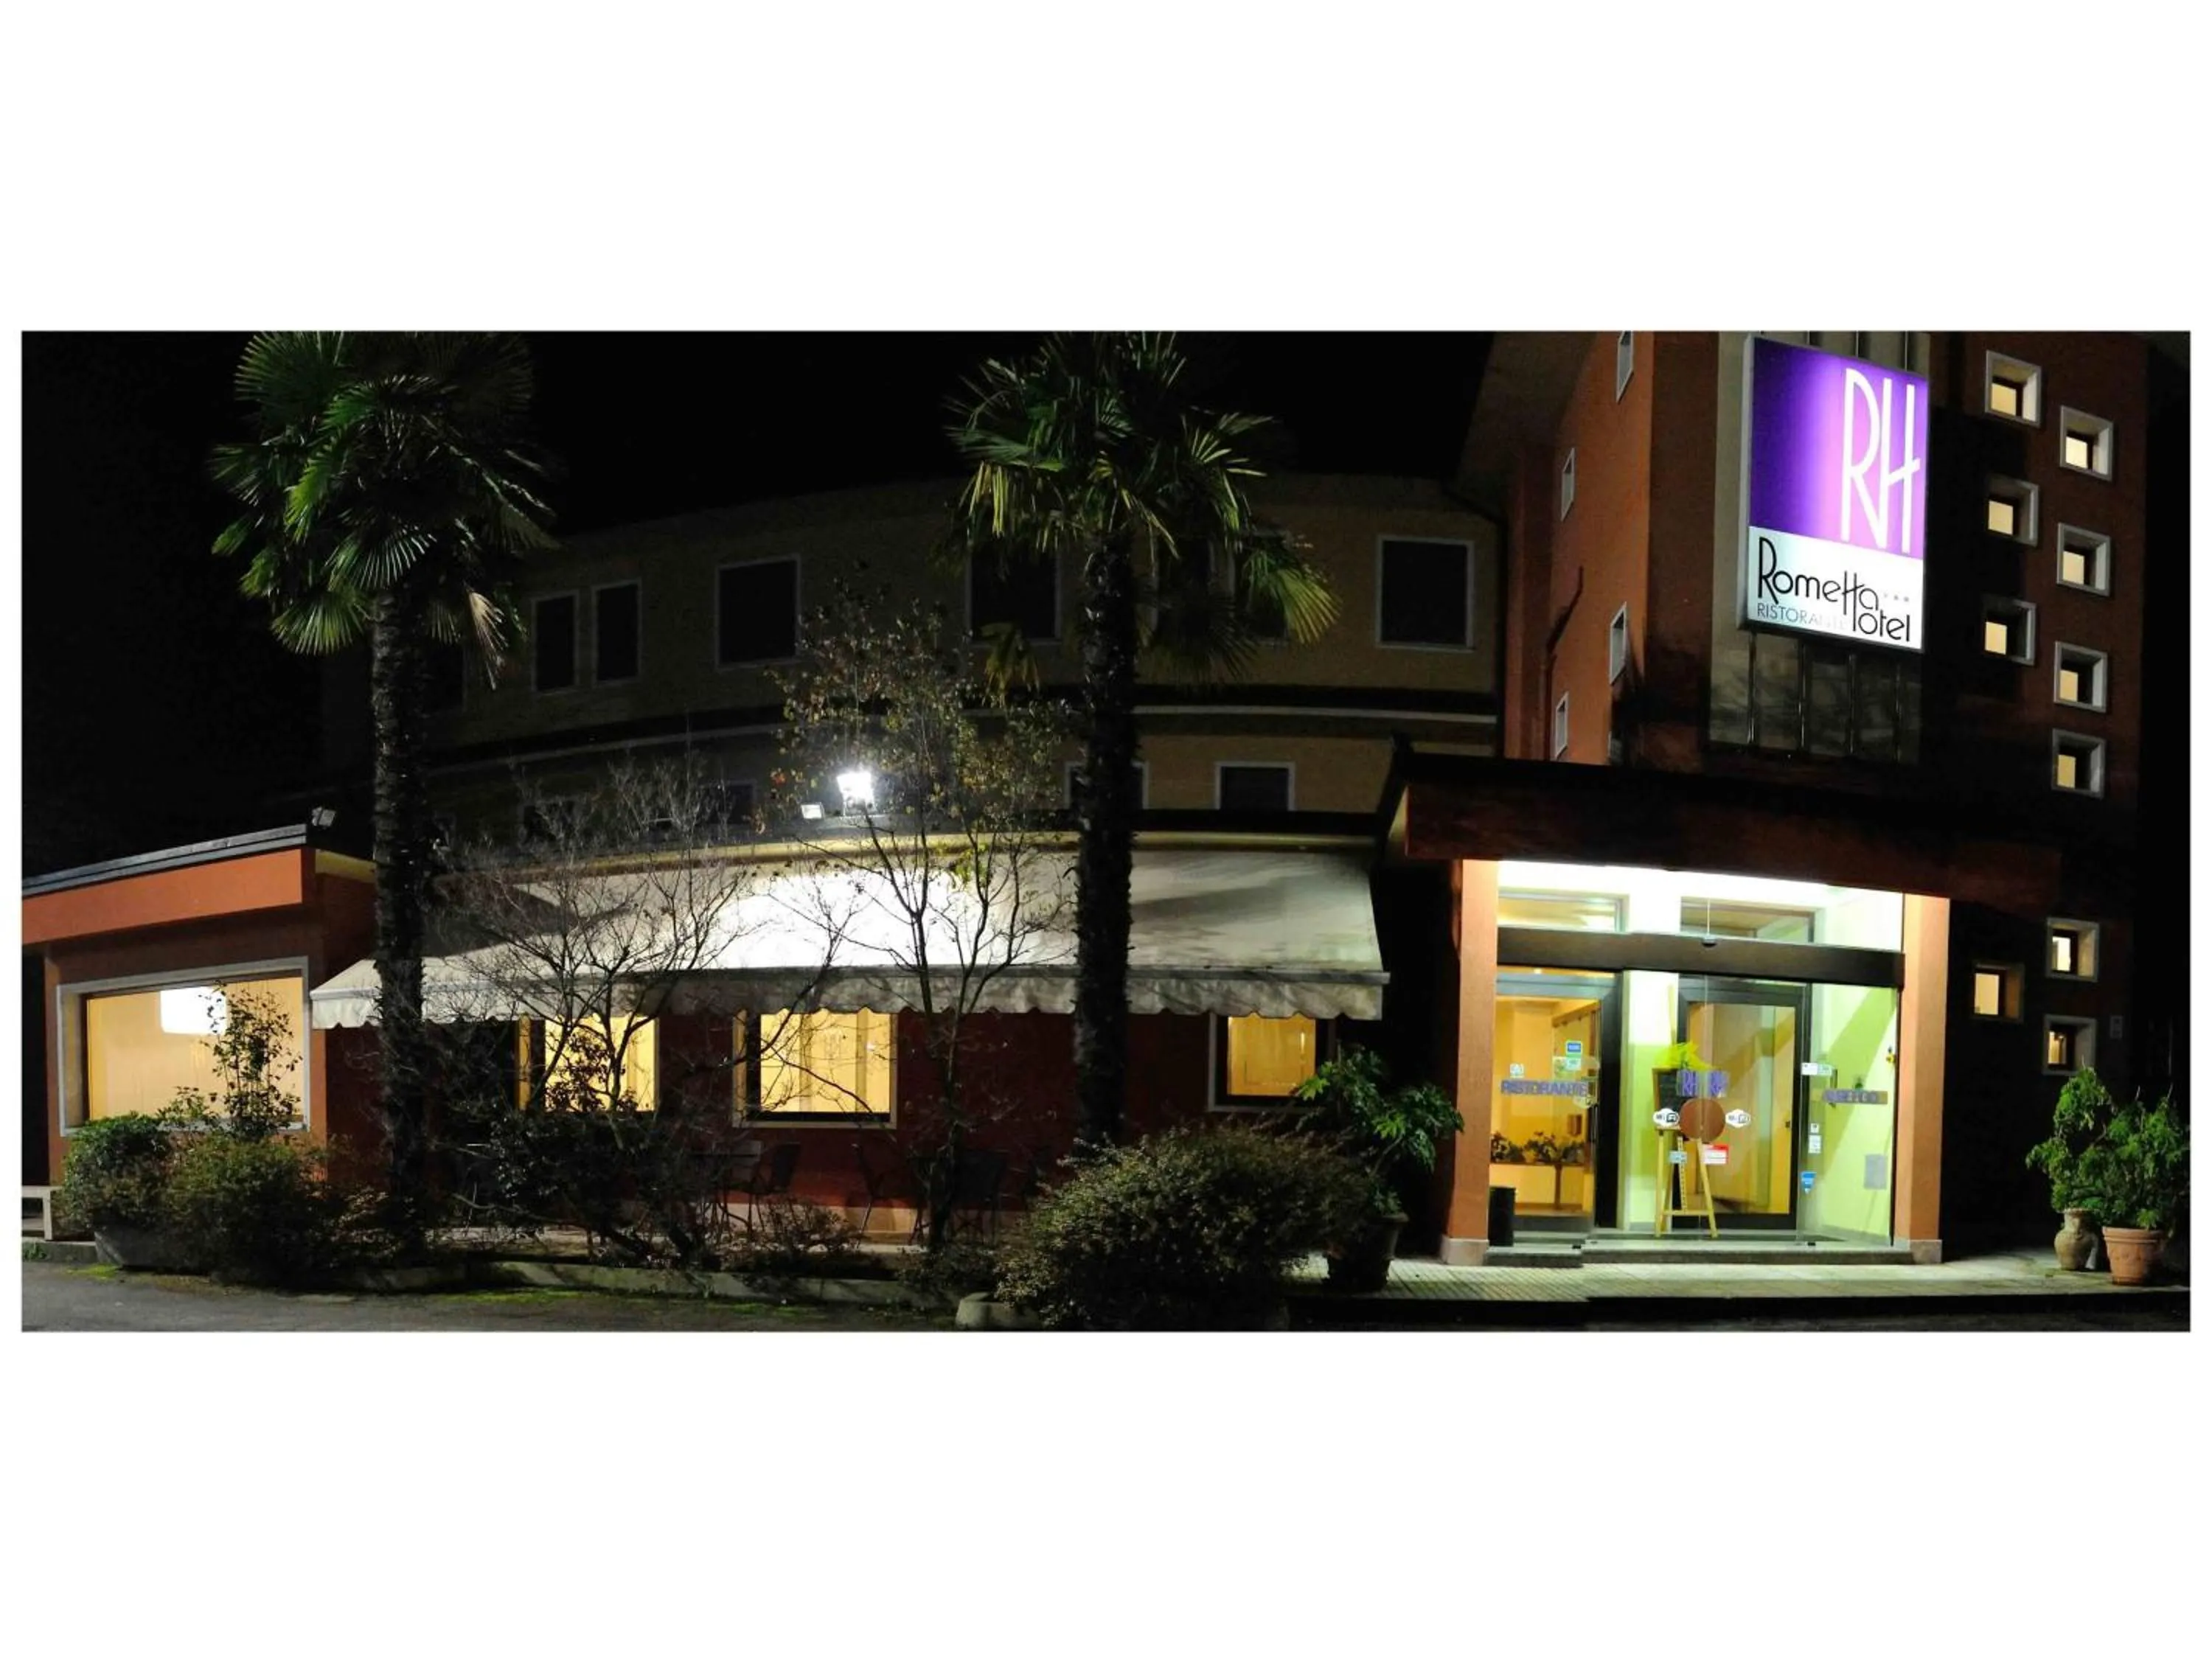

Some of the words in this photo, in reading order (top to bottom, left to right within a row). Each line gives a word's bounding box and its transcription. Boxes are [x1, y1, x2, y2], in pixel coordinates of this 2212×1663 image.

[1840, 367, 1921, 554] RH
[1757, 602, 1848, 630] RISTORA
[1758, 537, 1879, 616] Rometta
